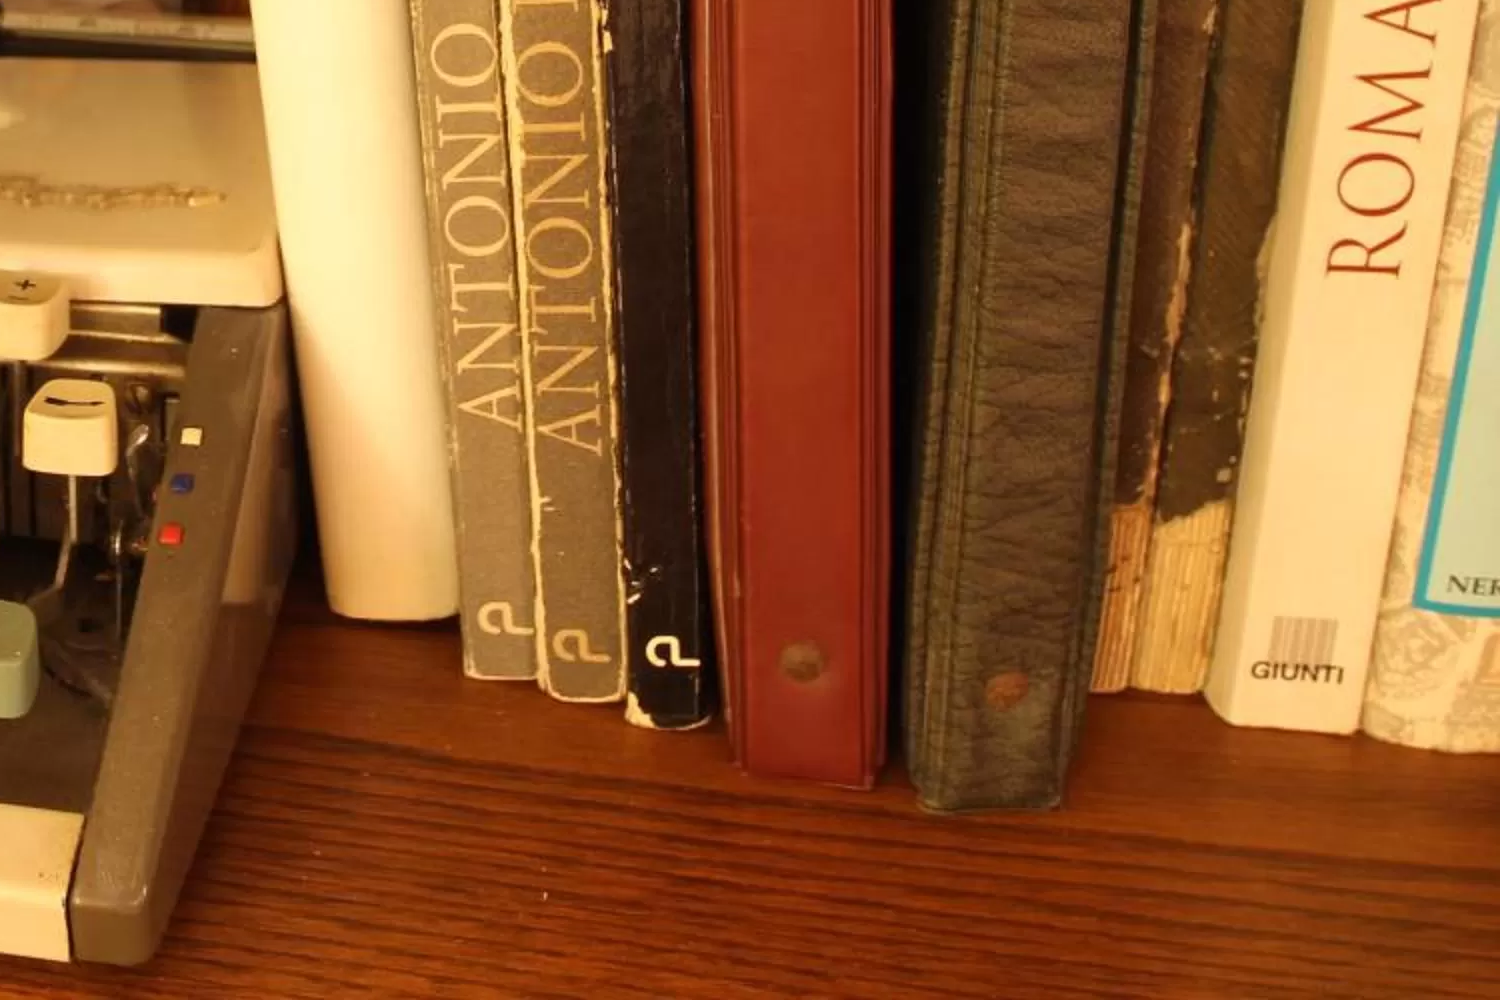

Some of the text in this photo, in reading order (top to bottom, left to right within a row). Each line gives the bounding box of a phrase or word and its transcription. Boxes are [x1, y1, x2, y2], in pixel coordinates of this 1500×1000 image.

[430, 22, 524, 432] ANTONIO
[516, 41, 602, 457] ANTONIO
[1250, 660, 1344, 684] GIUNTI
